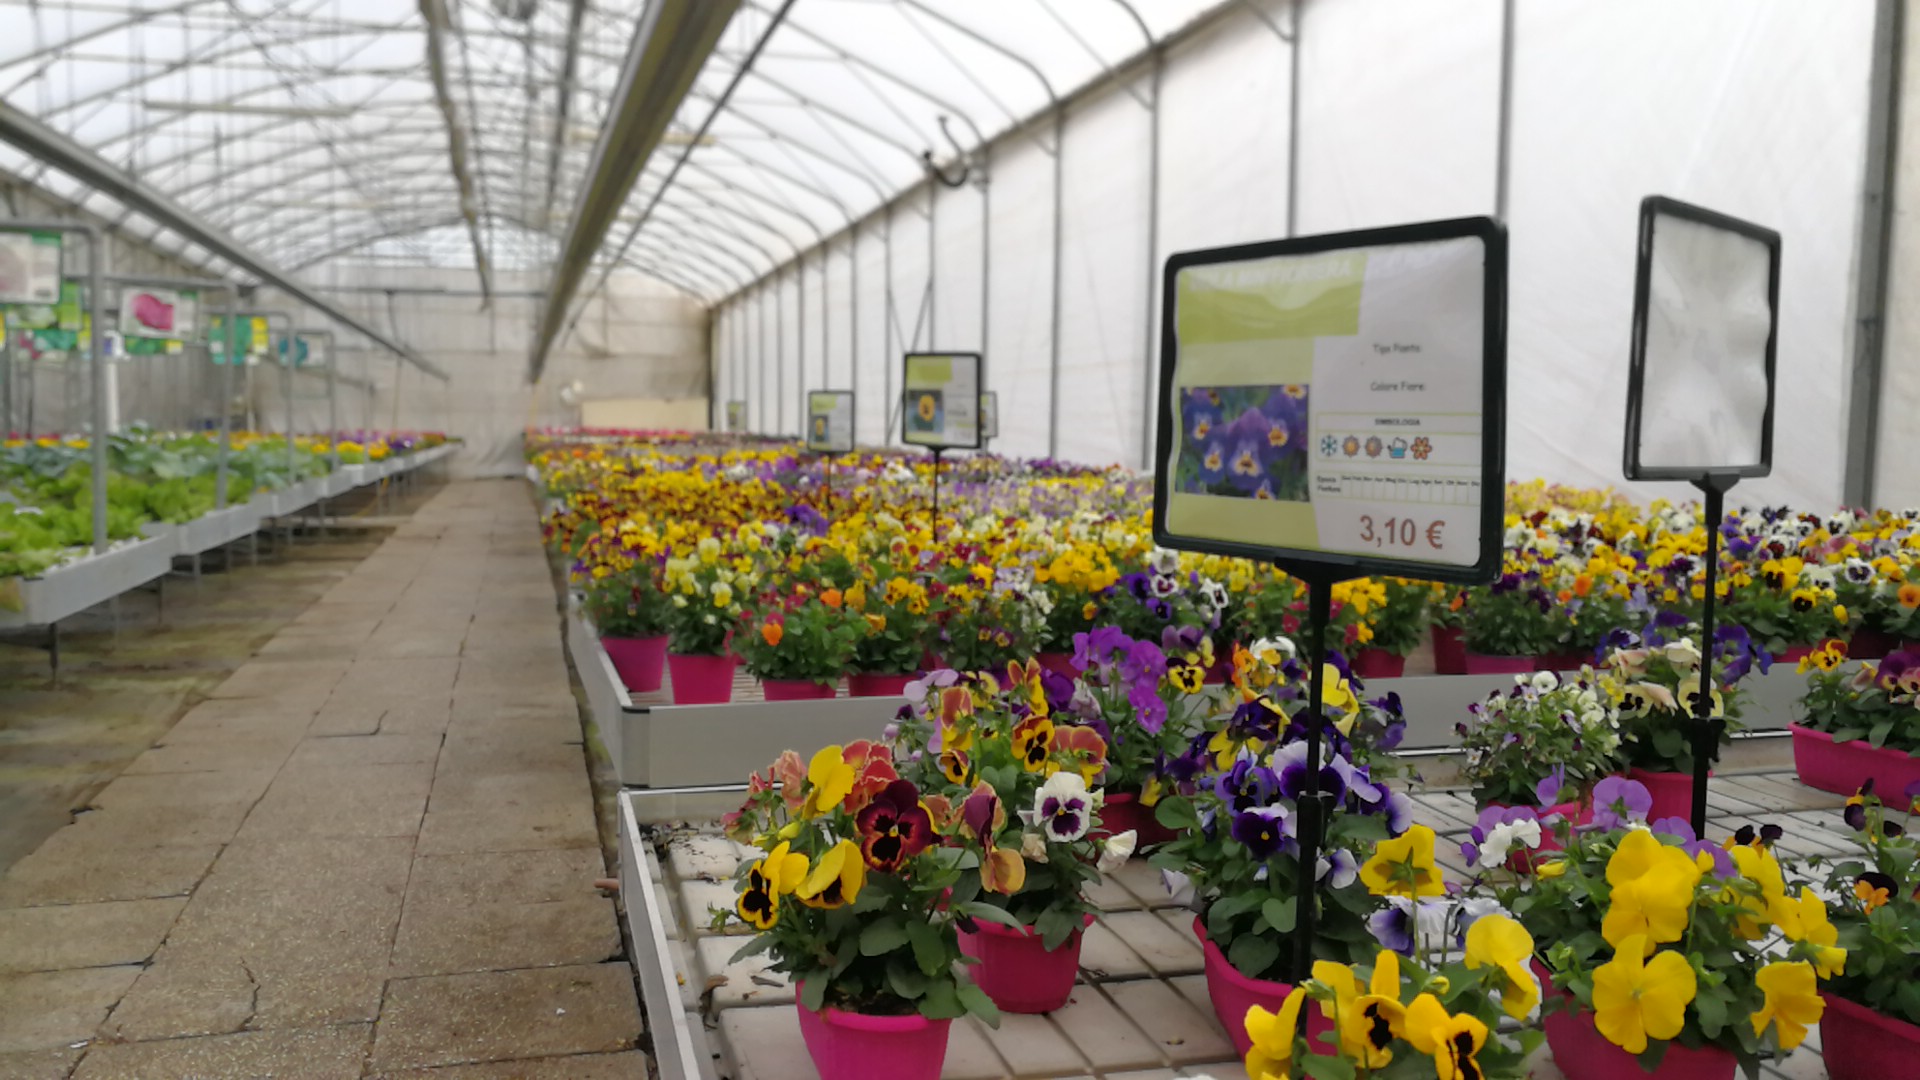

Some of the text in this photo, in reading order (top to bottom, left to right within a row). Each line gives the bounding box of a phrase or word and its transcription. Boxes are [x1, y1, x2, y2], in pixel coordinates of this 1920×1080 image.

[1370, 379, 1398, 391] Colore
[1360, 515, 1446, 550] 3,10 €
